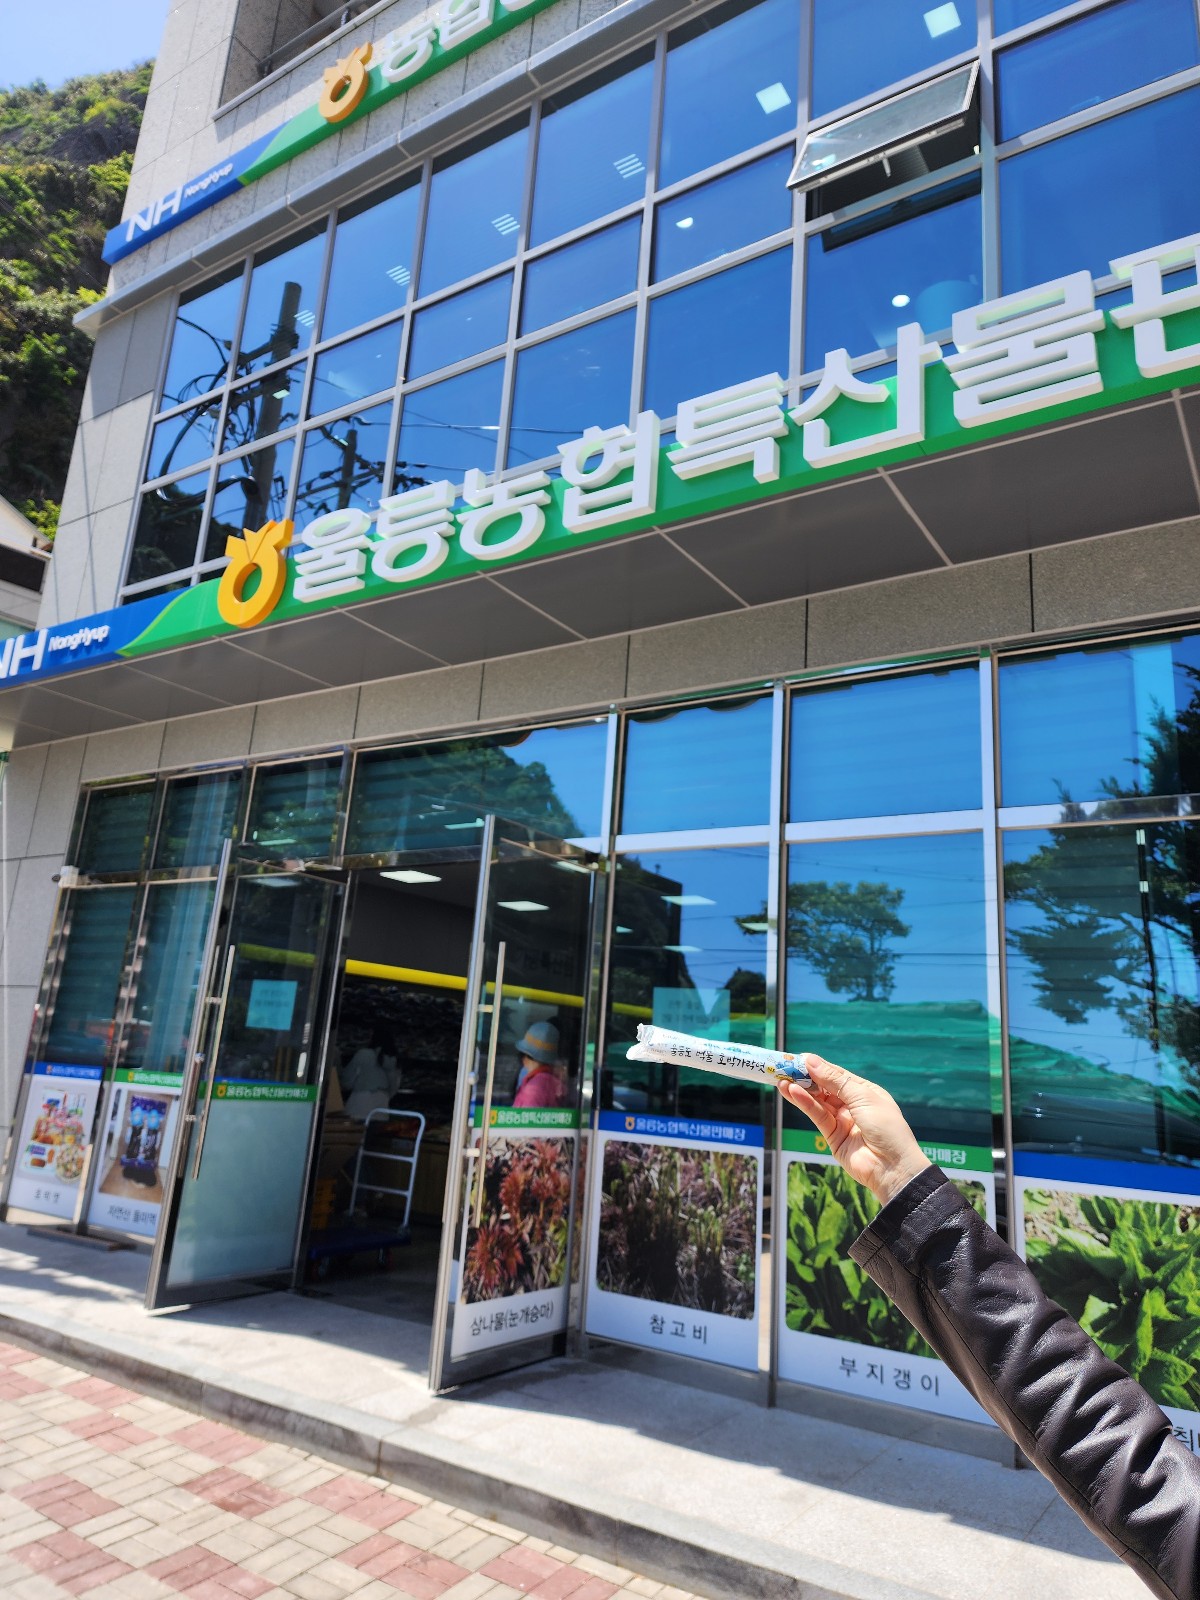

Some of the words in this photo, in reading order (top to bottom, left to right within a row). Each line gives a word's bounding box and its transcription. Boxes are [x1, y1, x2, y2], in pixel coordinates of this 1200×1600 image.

[380, 0, 536, 84] 농협
[125, 184, 185, 242] NH
[183, 162, 234, 199] NongHyup
[48, 624, 110, 652] NongHyup
[497, 1111, 573, 1126] 울릉농협특산물판매장
[635, 1118, 746, 1142] 울릉농협특산물판매장
